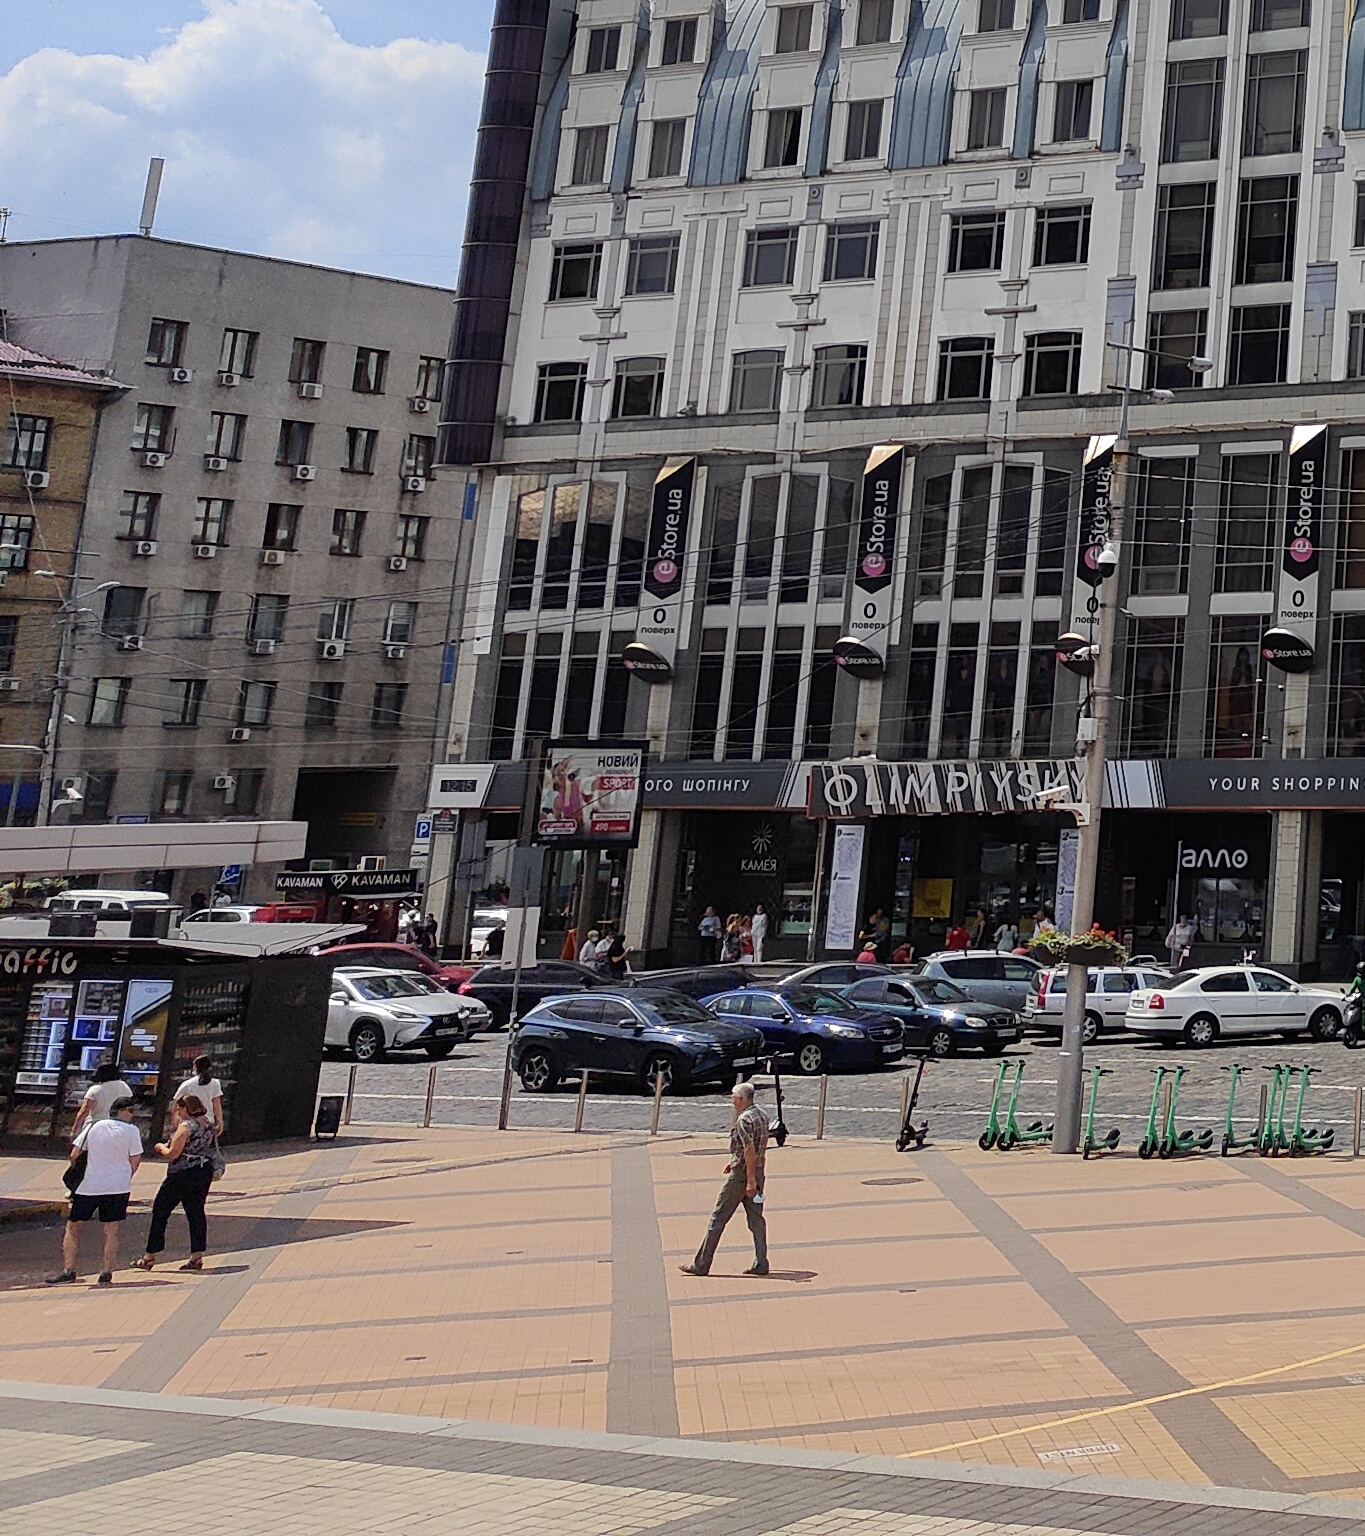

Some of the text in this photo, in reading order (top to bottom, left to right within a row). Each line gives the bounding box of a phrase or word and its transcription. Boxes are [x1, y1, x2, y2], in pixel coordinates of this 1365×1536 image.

[1294, 461, 1315, 552] eStore.ua
[867, 480, 889, 567] eStore.ua
[658, 489, 683, 574] eStore.ua
[1087, 597, 1099, 612] 0
[1292, 590, 1305, 607] 0
[653, 608, 666, 624] 0
[863, 603, 877, 619] 0
[1281, 611, 1314, 619] поверх
[641, 627, 676, 635] поверх
[851, 622, 886, 630] поверх
[597, 753, 639, 768] НОВИЙ
[603, 778, 633, 789] SPORT
[645, 779, 750, 792] ОГО ШОПІНГУ
[824, 769, 1086, 807] OLIMPIYSKY
[1209, 777, 1261, 791] YOUR
[277, 877, 323, 888] KAVAMAN
[351, 873, 411, 886] KAVAMAN
[0, 947, 78, 975] affic
